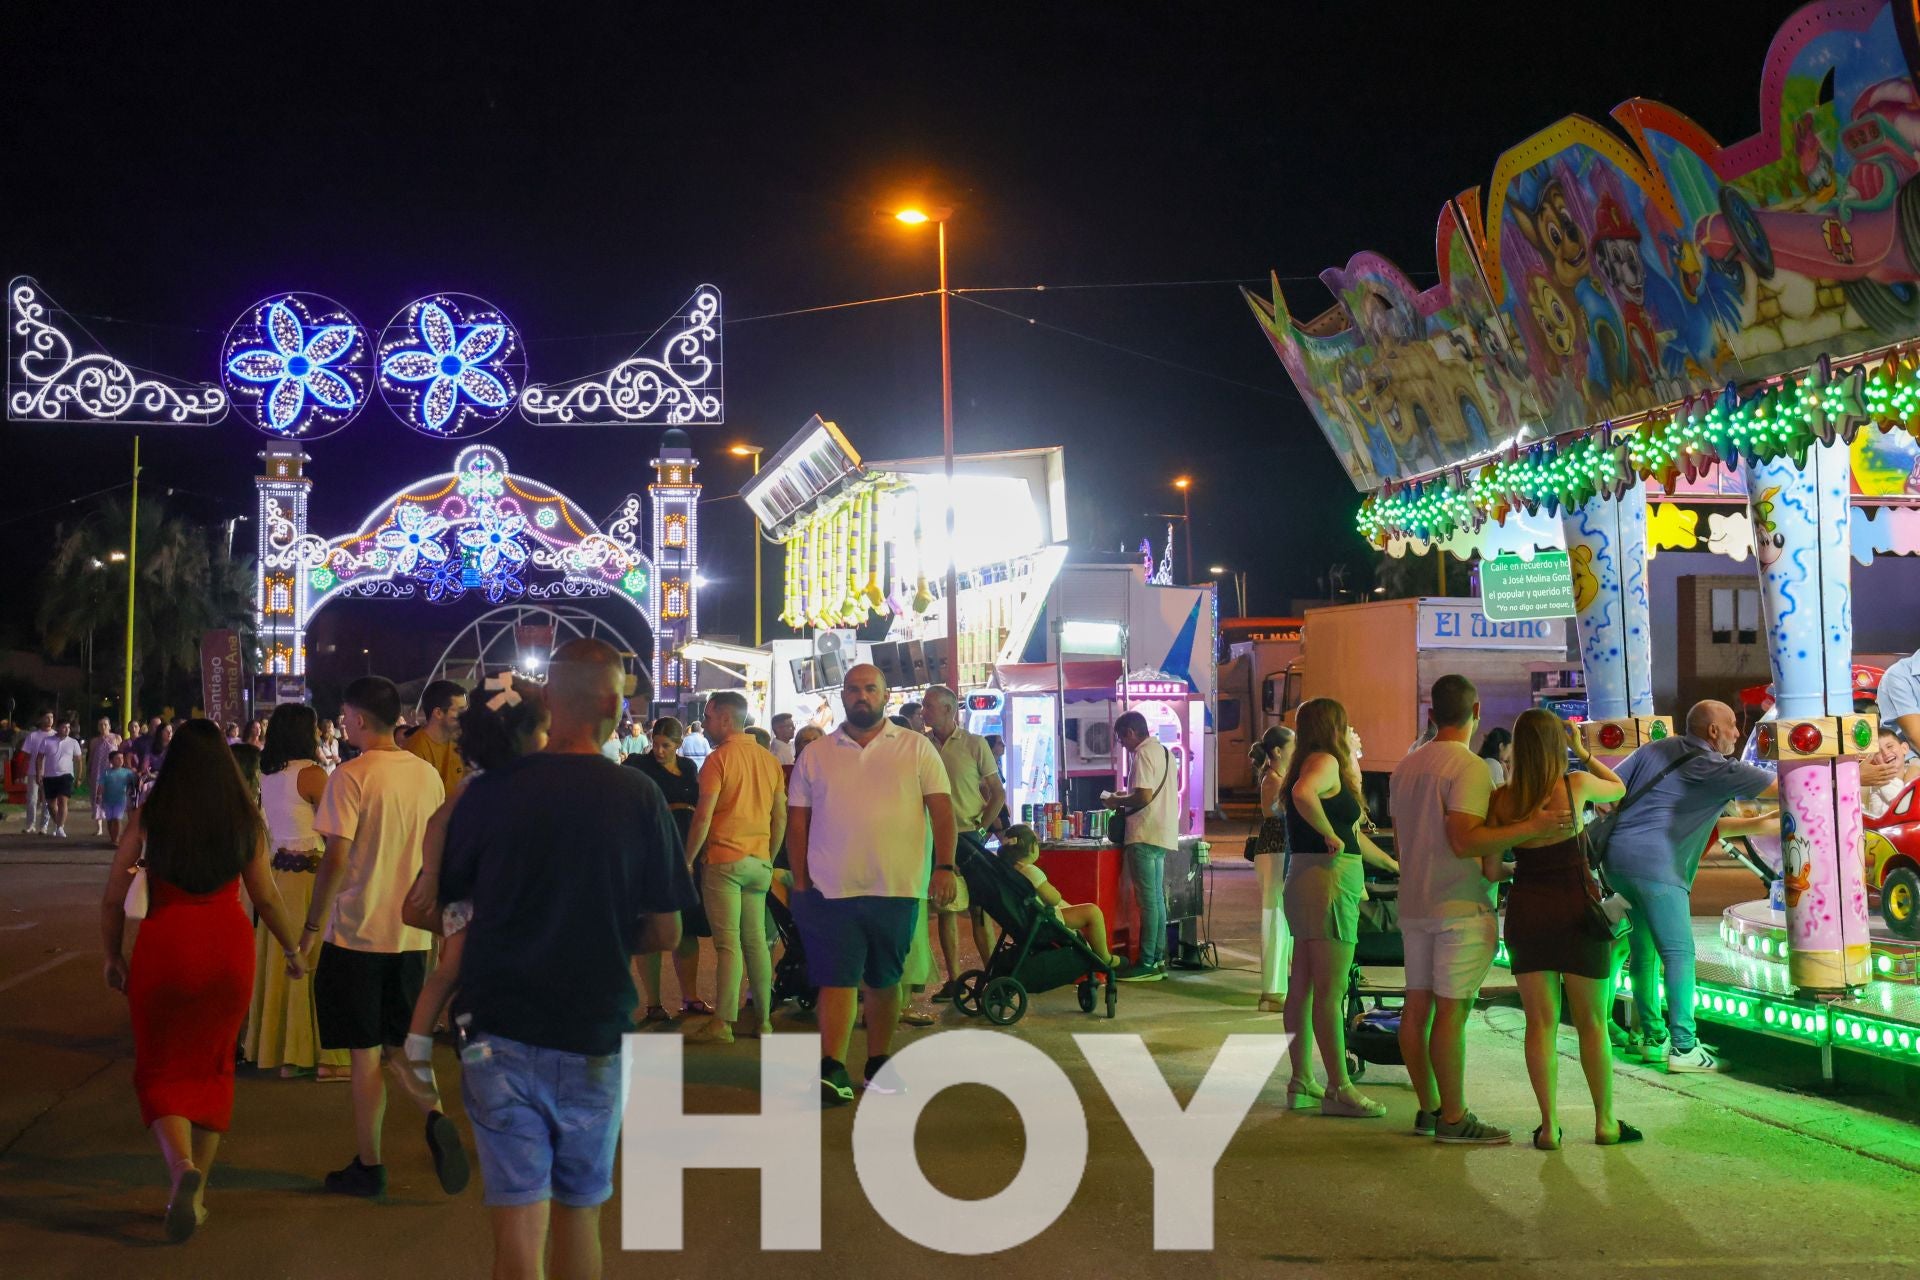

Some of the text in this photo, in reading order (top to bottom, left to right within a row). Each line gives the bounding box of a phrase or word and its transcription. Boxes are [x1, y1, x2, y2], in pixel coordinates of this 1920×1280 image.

[1490, 563, 1508, 572] Calle
[1510, 563, 1519, 571] en
[1521, 560, 1552, 570] recuerdo
[1553, 561, 1559, 570] y
[1502, 577, 1507, 585] a
[1509, 574, 1524, 585] José
[1526, 574, 1551, 584] Molina
[1488, 591, 1496, 600] el
[1497, 590, 1525, 601] popular
[1526, 590, 1532, 598] y
[1532, 587, 1560, 599] querido
[1519, 603, 1533, 612] digo
[1535, 602, 1548, 611] que
[1434, 612, 1461, 637] El
[224, 635, 238, 664] Ana
[208, 656, 224, 721] Santiago
[224, 667, 238, 710] Santa
